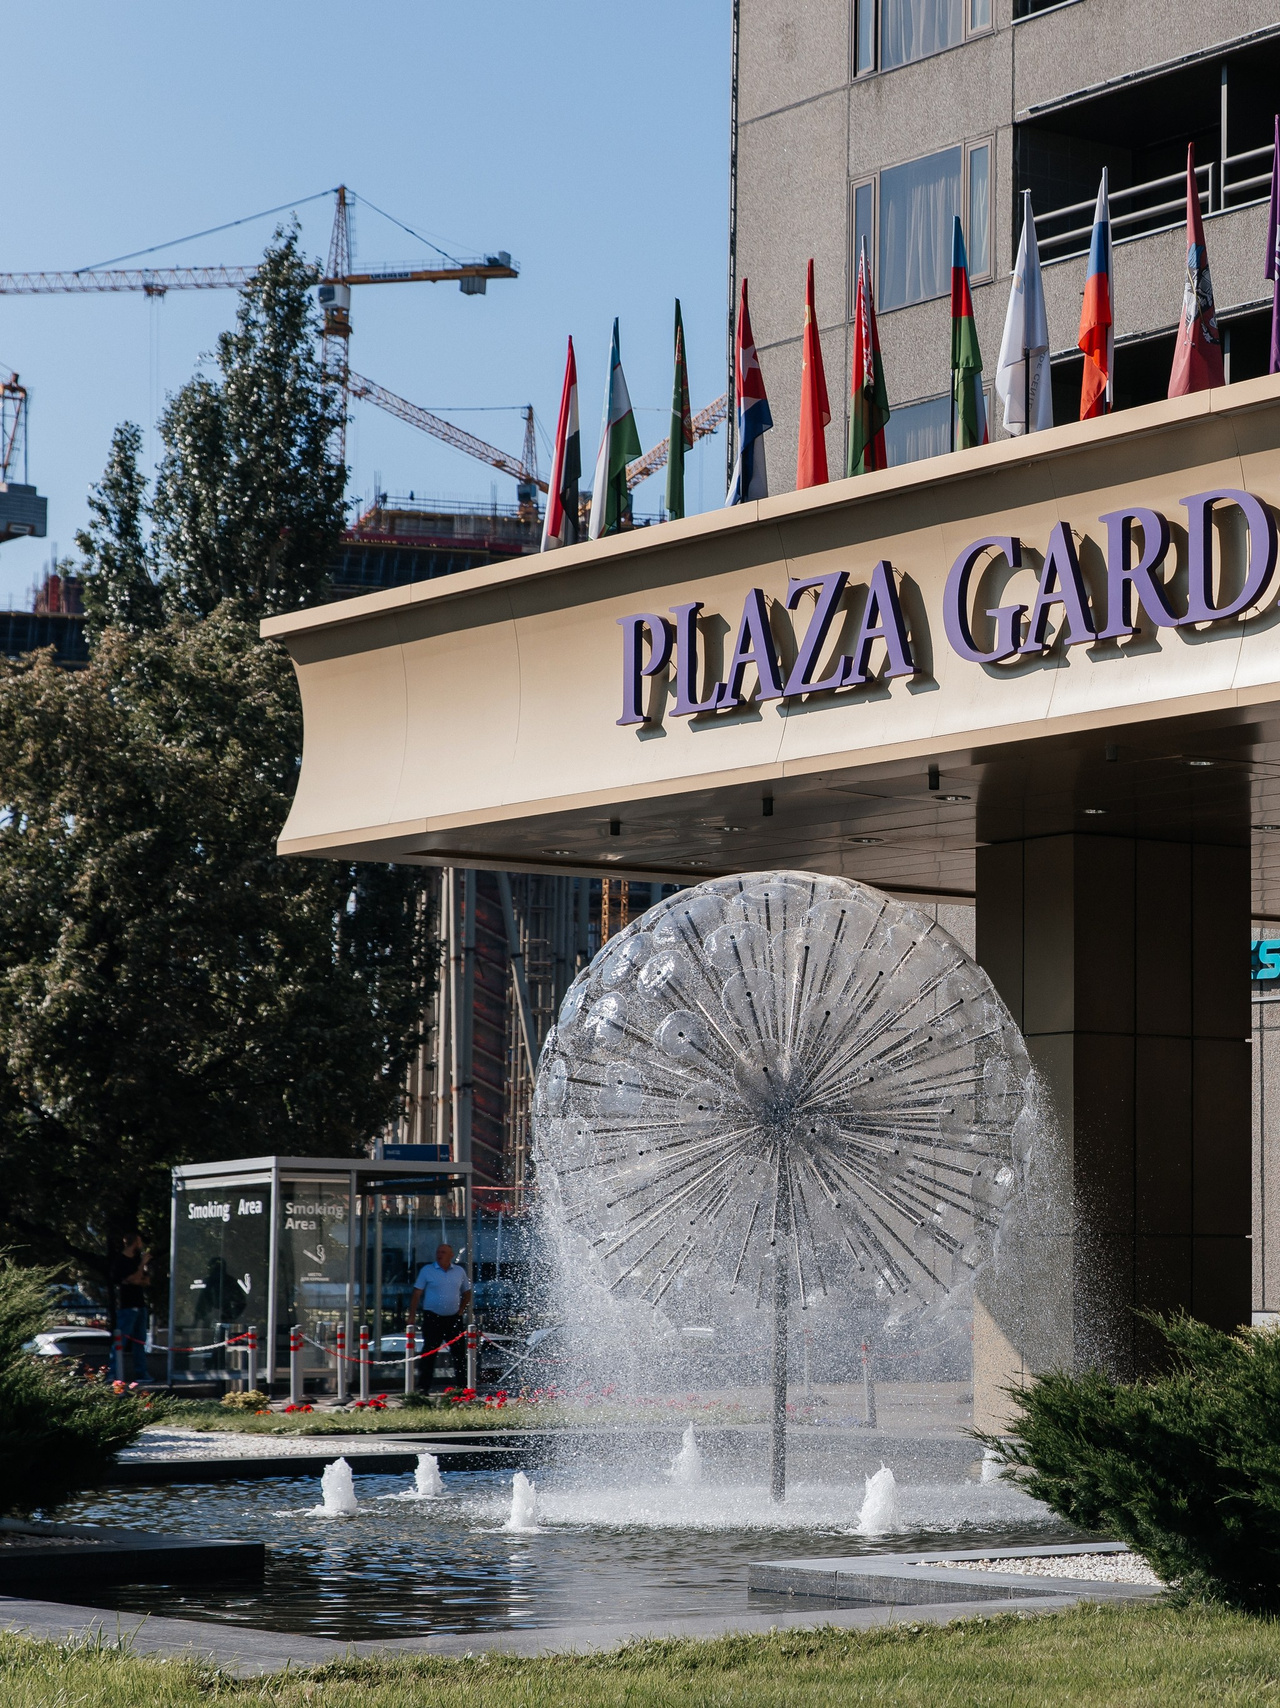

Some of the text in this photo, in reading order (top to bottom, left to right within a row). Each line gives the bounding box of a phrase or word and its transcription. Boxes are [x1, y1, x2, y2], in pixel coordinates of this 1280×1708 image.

[616, 559, 923, 726] PLAZA
[188, 1198, 263, 1222] Smoking Area
[285, 1202, 344, 1219] Smoking
[285, 1217, 317, 1231] Area
